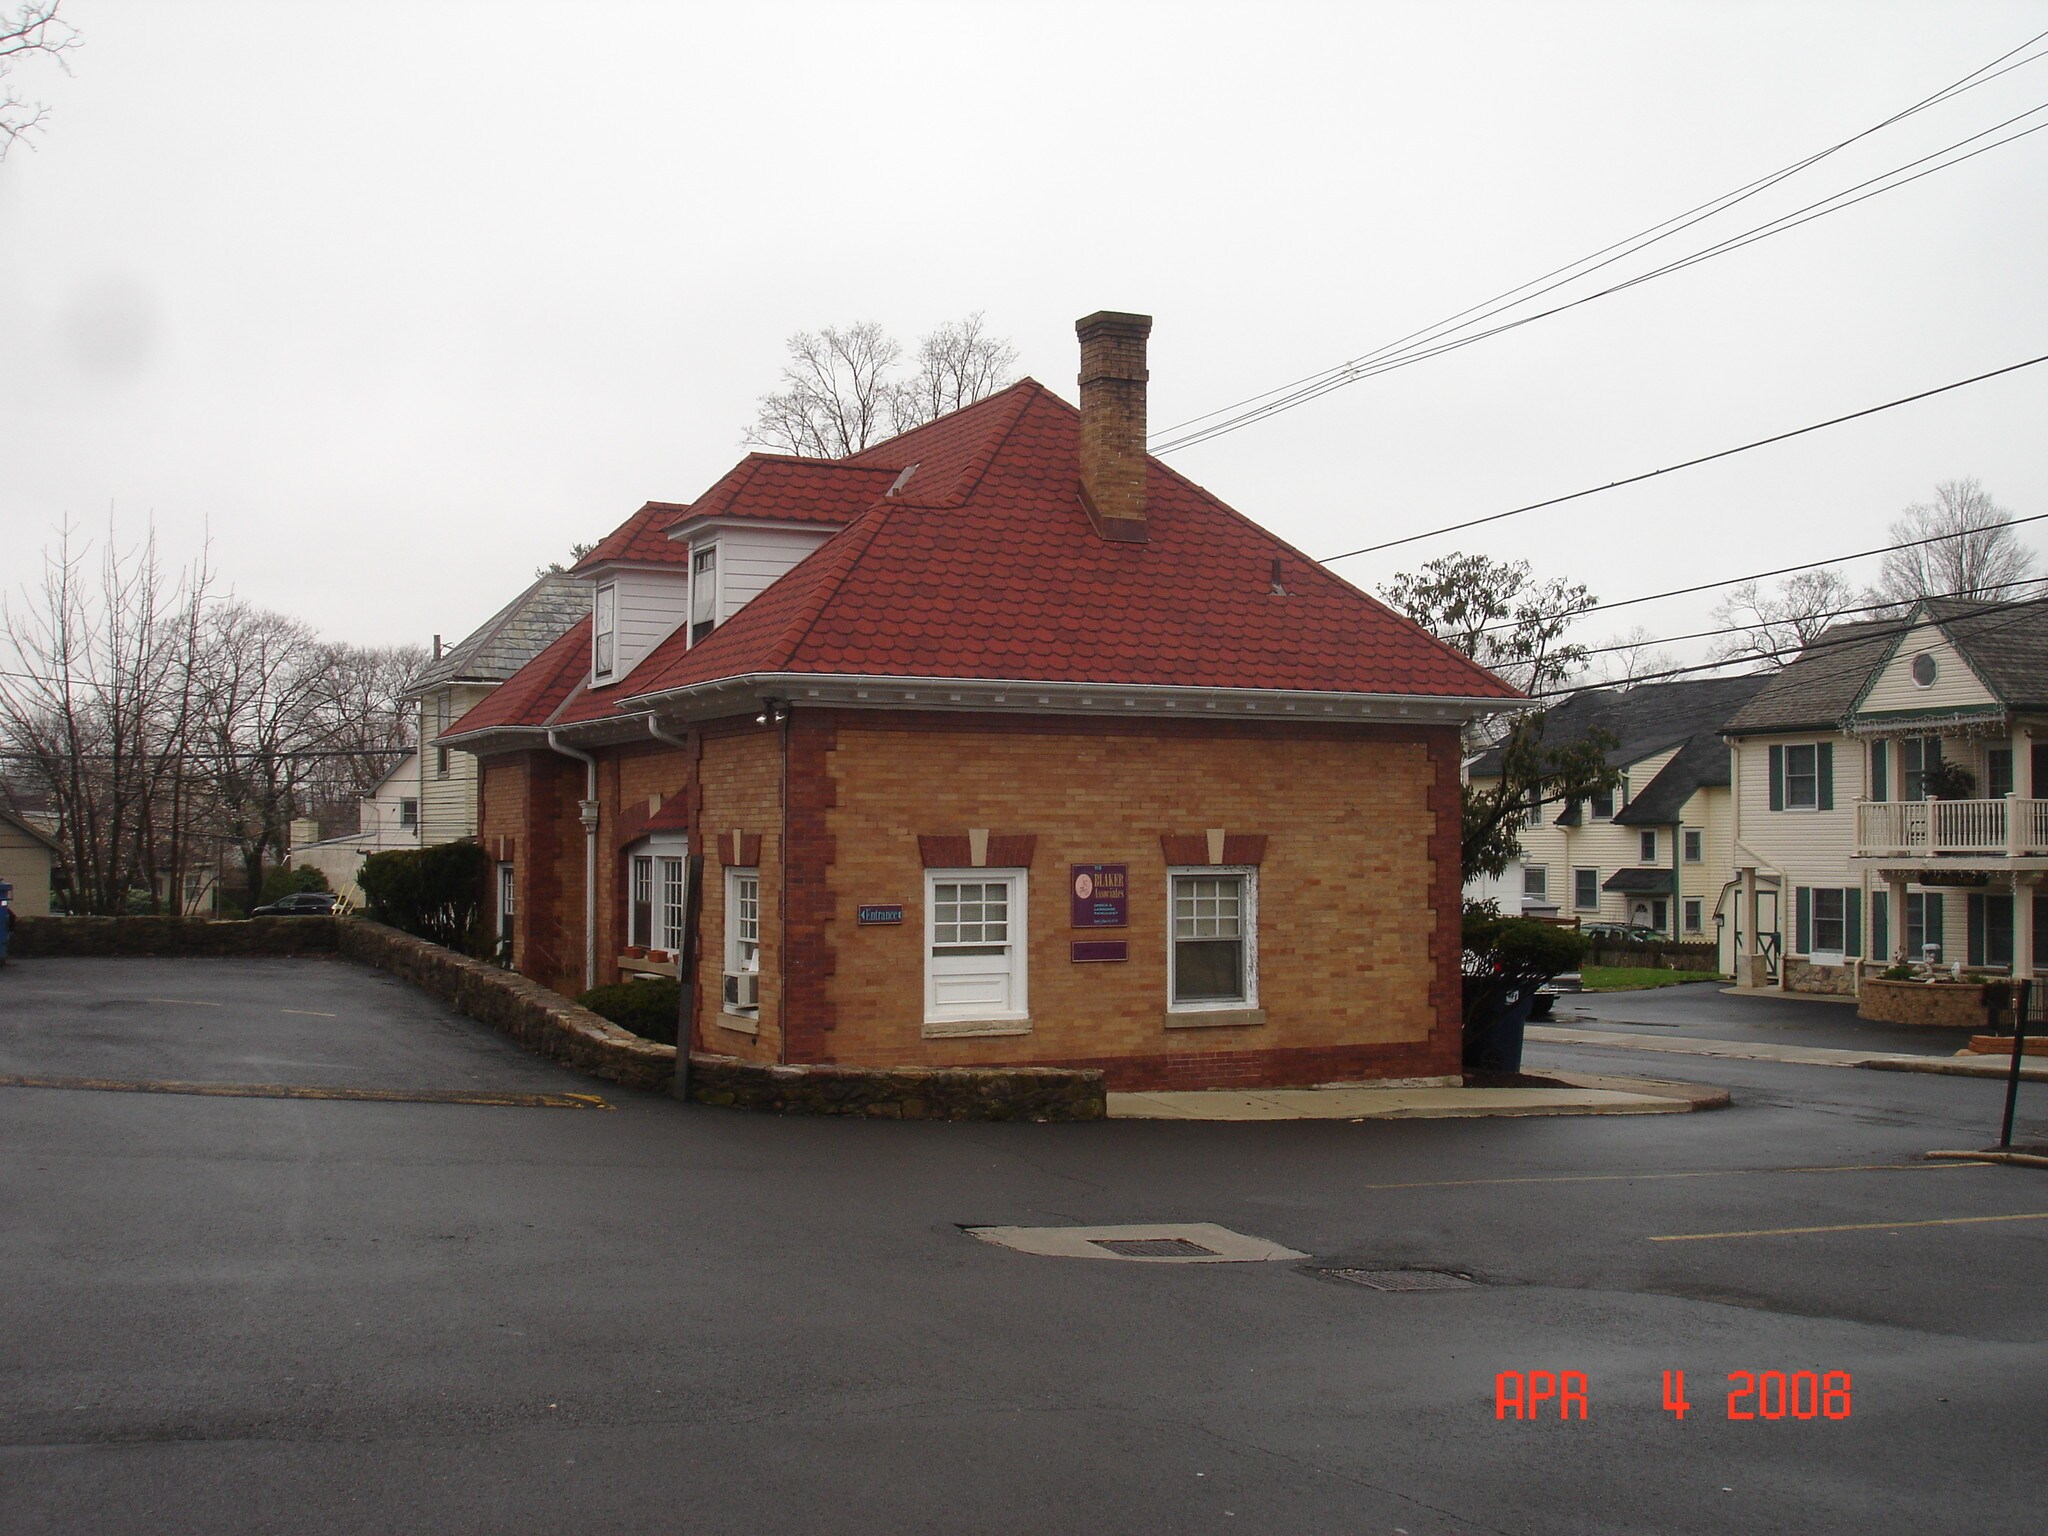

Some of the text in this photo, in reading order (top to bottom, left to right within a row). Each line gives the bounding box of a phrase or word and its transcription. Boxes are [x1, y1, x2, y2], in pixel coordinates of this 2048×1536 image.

[1094, 873, 1124, 887] BLAKER
[1094, 888, 1124, 898] Associates
[865, 908, 898, 921] Entrance
